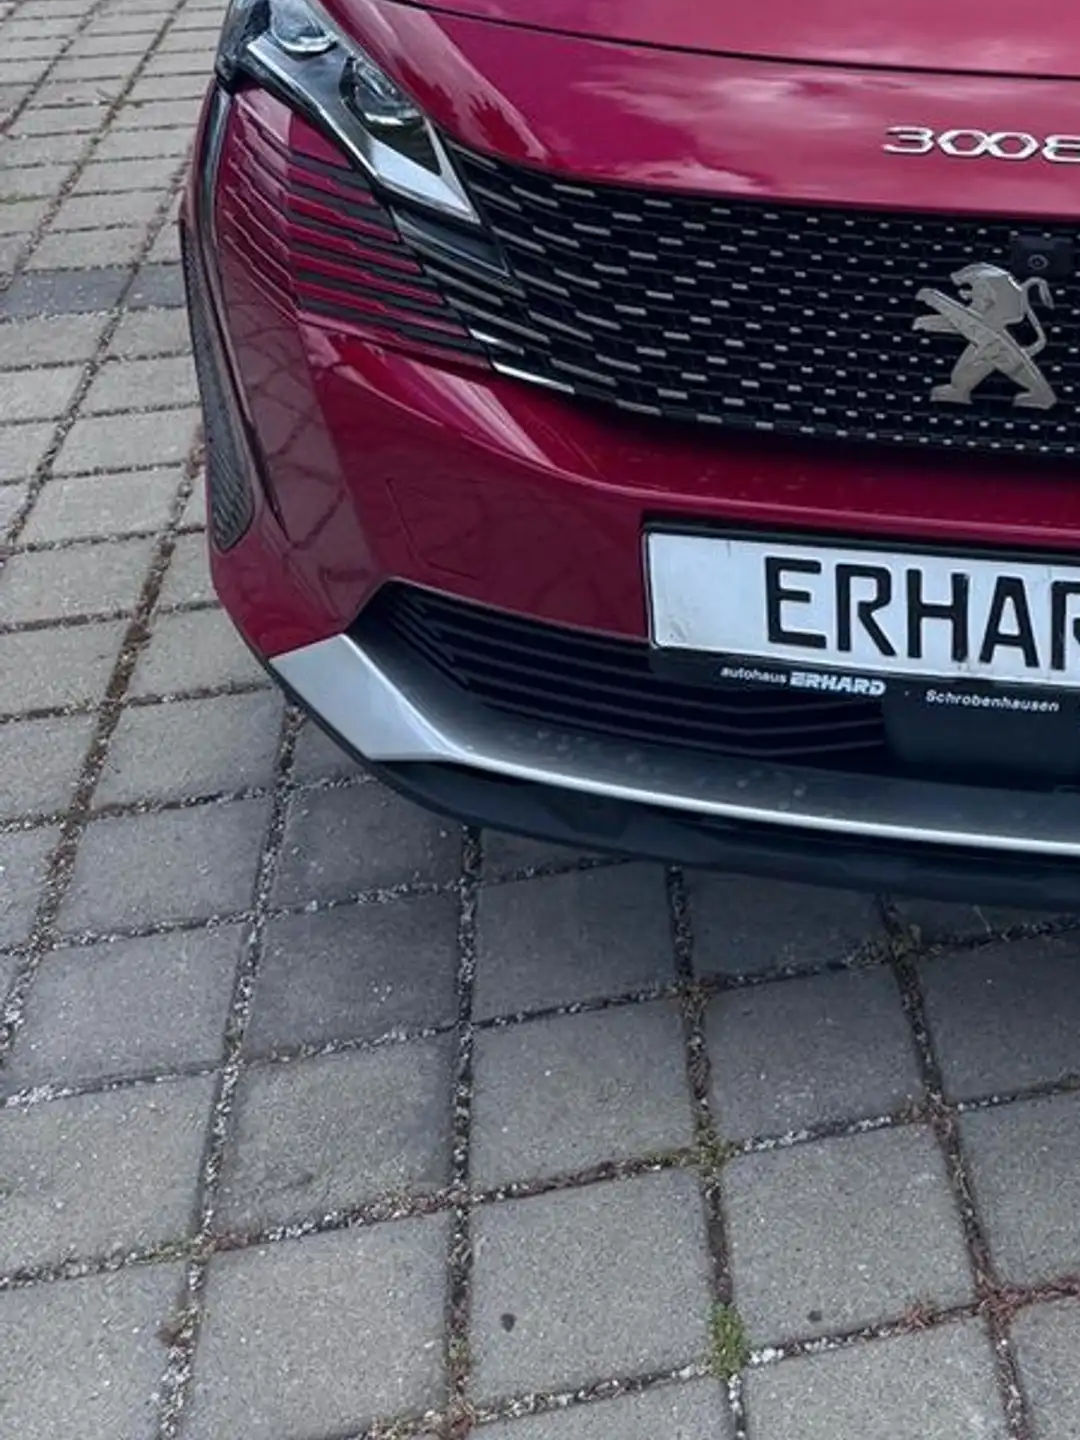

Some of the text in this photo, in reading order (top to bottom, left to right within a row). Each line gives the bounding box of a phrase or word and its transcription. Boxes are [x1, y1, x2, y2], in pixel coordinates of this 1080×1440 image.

[720, 666, 787, 685] autohaus
[790, 671, 887, 697] ERHARD
[925, 689, 1060, 712] Schrobenhausen
